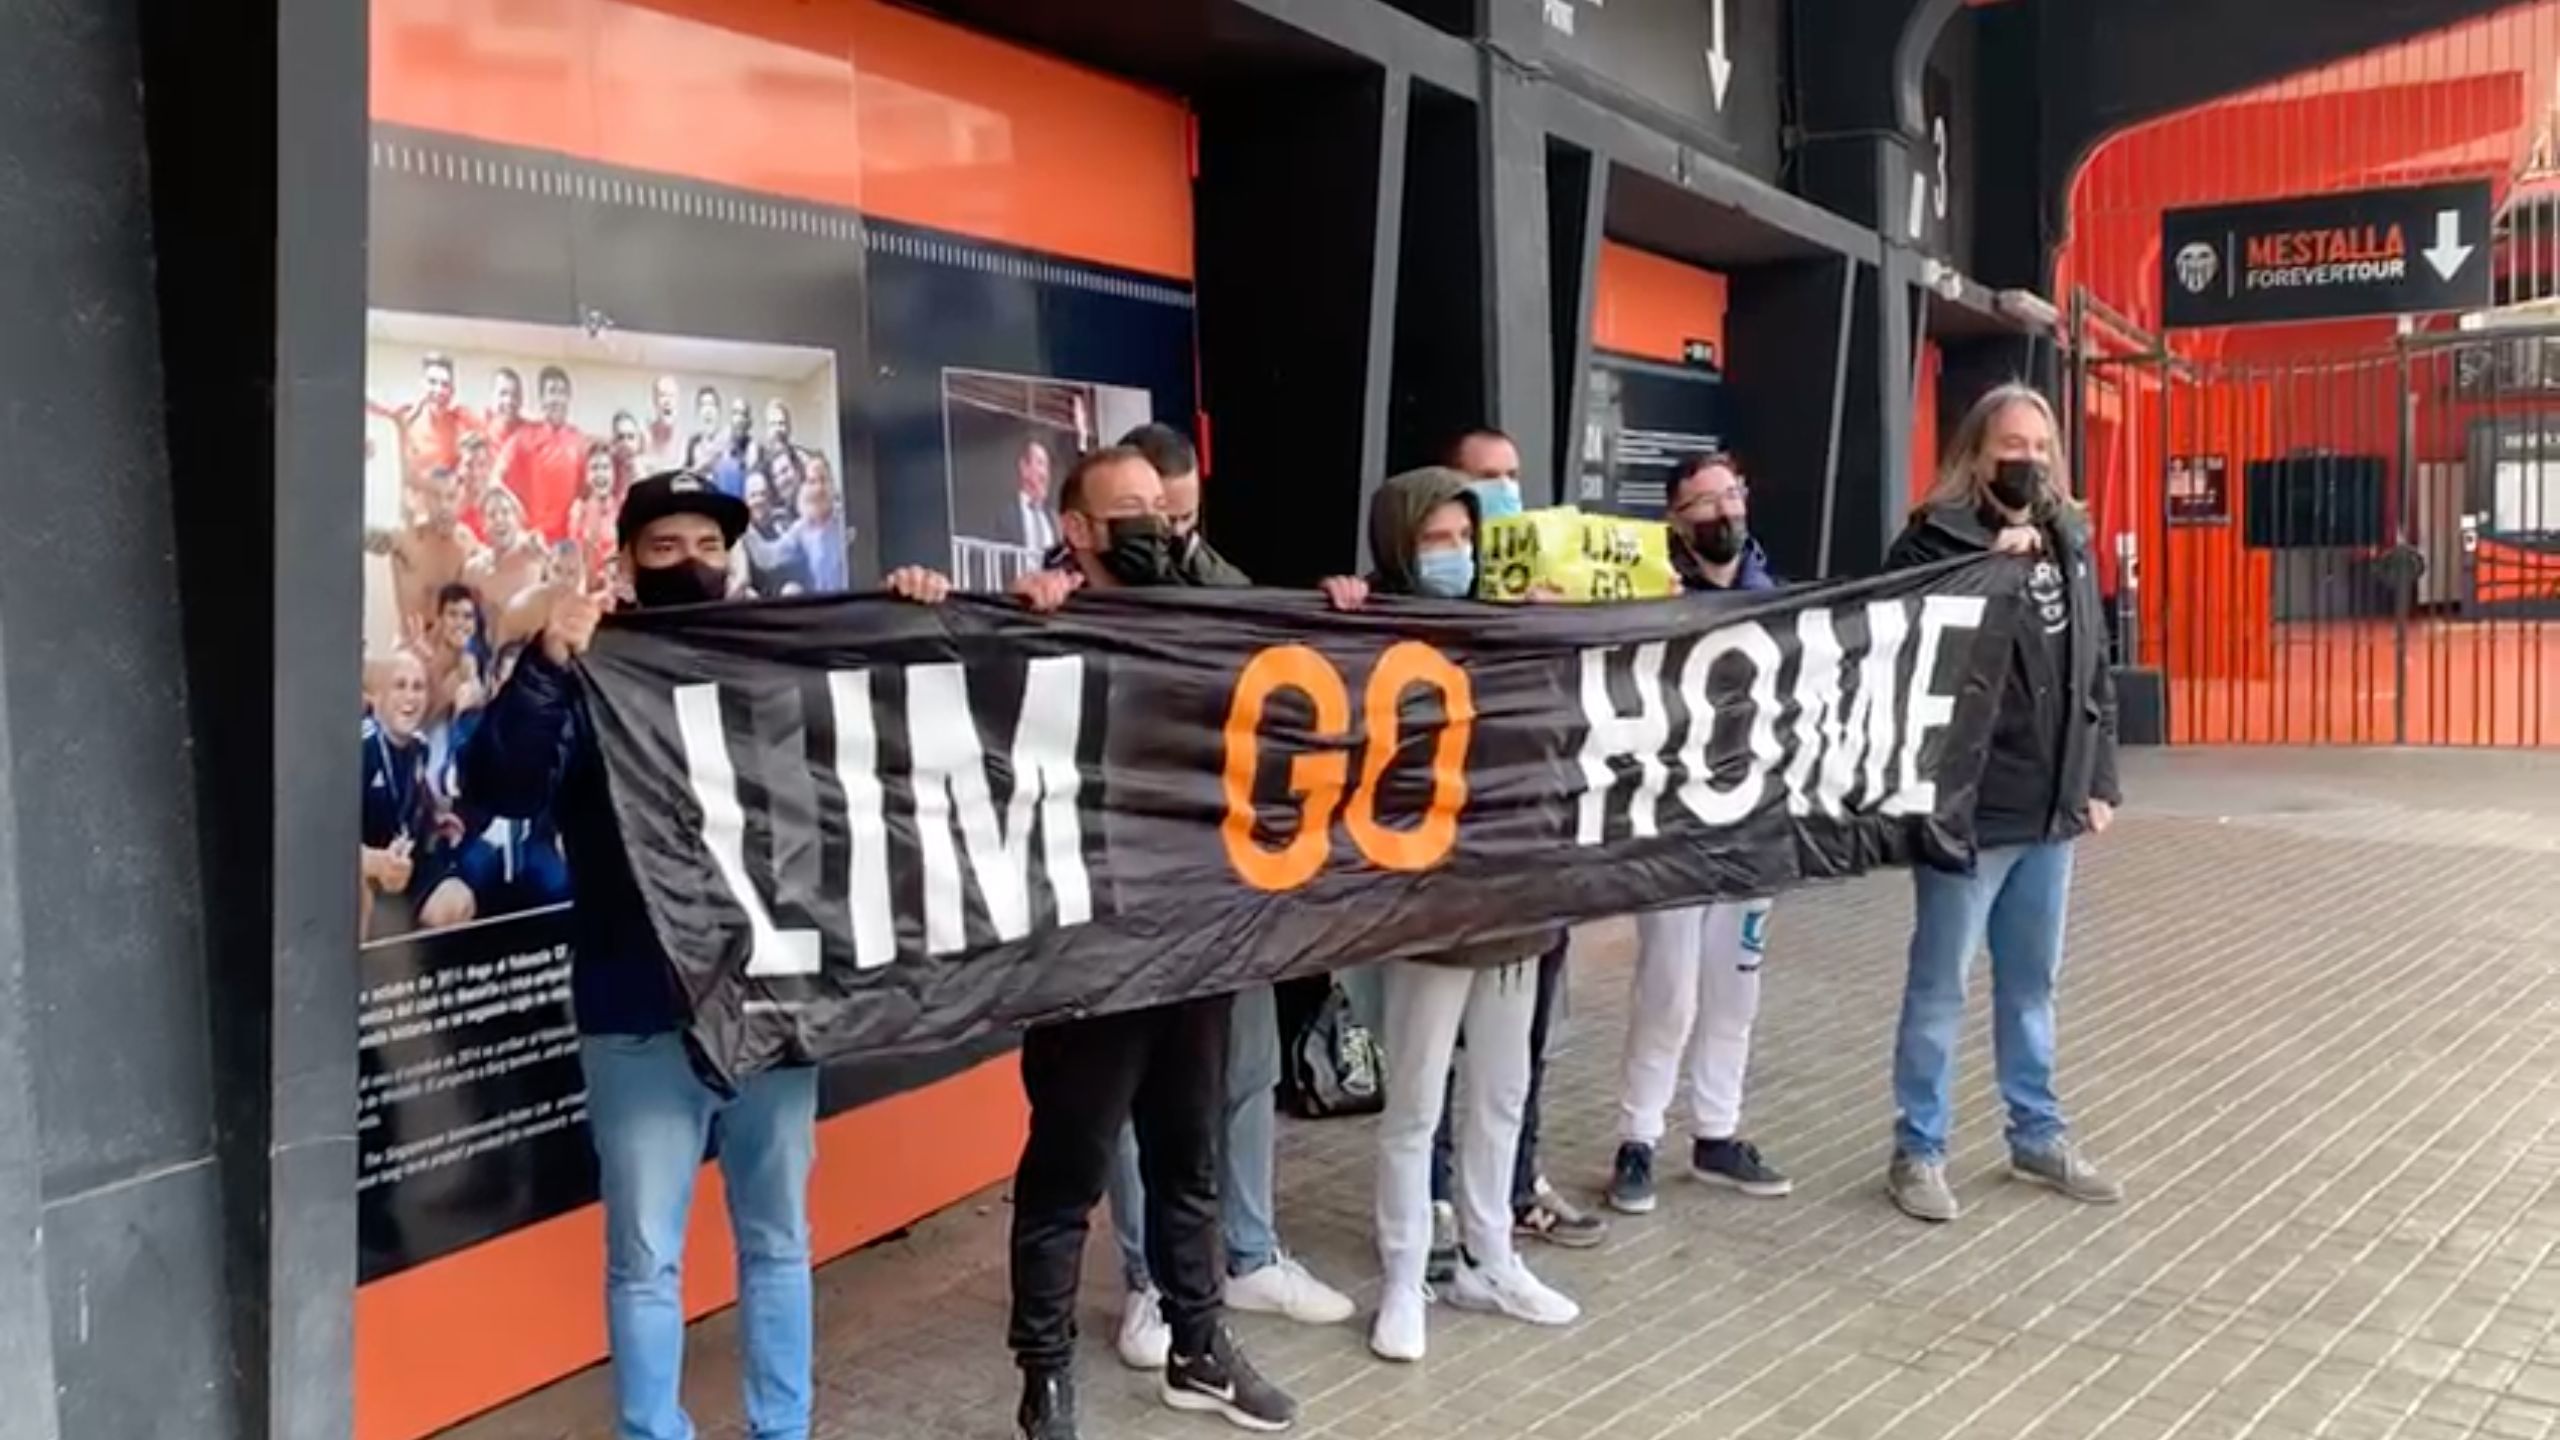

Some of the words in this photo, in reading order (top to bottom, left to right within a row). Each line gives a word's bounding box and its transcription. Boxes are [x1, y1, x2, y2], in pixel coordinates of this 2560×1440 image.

[2246, 223, 2405, 266] MESTALLA
[2246, 259, 2405, 290] FOREVERTOUR
[1483, 521, 1541, 561] IM
[673, 654, 1093, 977] LIM
[1222, 641, 1475, 891] GO
[1576, 595, 1988, 846] HOME
